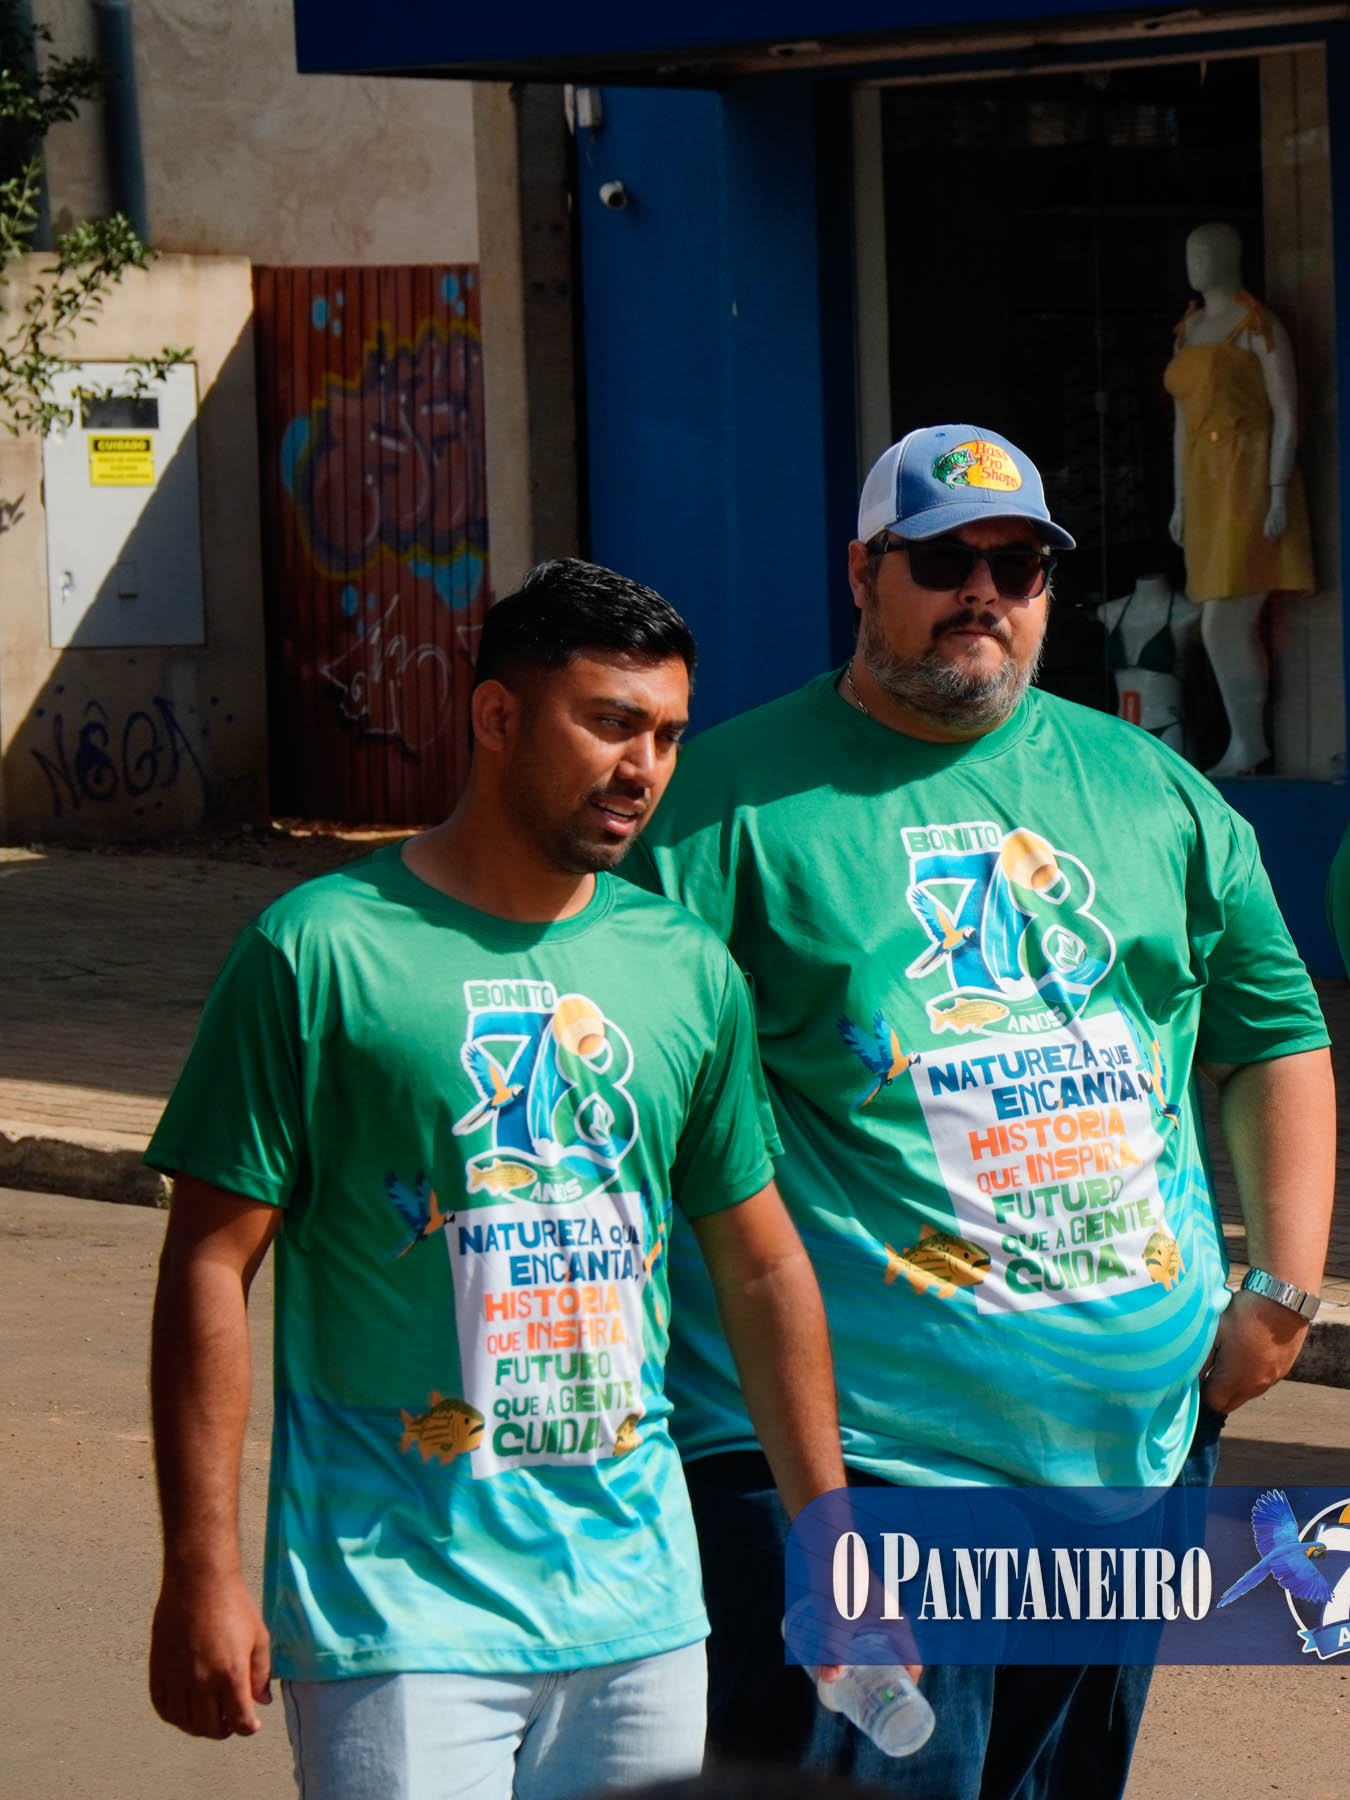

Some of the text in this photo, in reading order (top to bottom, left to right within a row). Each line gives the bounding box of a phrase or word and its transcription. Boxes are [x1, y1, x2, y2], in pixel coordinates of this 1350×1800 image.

[975, 440, 1008, 461] Bass
[979, 454, 1003, 470] Pro
[980, 467, 1020, 488] Shops
[906, 825, 998, 852] BONITO
[467, 983, 554, 1009] BONITO
[1007, 1007, 1067, 1034] ANOS
[927, 1039, 1132, 1096] NATUREZA QUE
[991, 1070, 1143, 1121] ENCANTA,
[529, 1177, 584, 1202] ANOS
[977, 1165, 1023, 1195] QUE
[991, 1175, 1124, 1225] FUTURO
[458, 1218, 603, 1256] NATUREZA
[1001, 1198, 1156, 1257] QUE A GENTE
[509, 1250, 640, 1287] ENCANTA,
[1005, 1243, 1136, 1294] CUIDA.
[487, 1331, 521, 1356] QUE
[495, 1351, 612, 1386] FUTURO
[492, 1381, 634, 1420] QUE A GENTE
